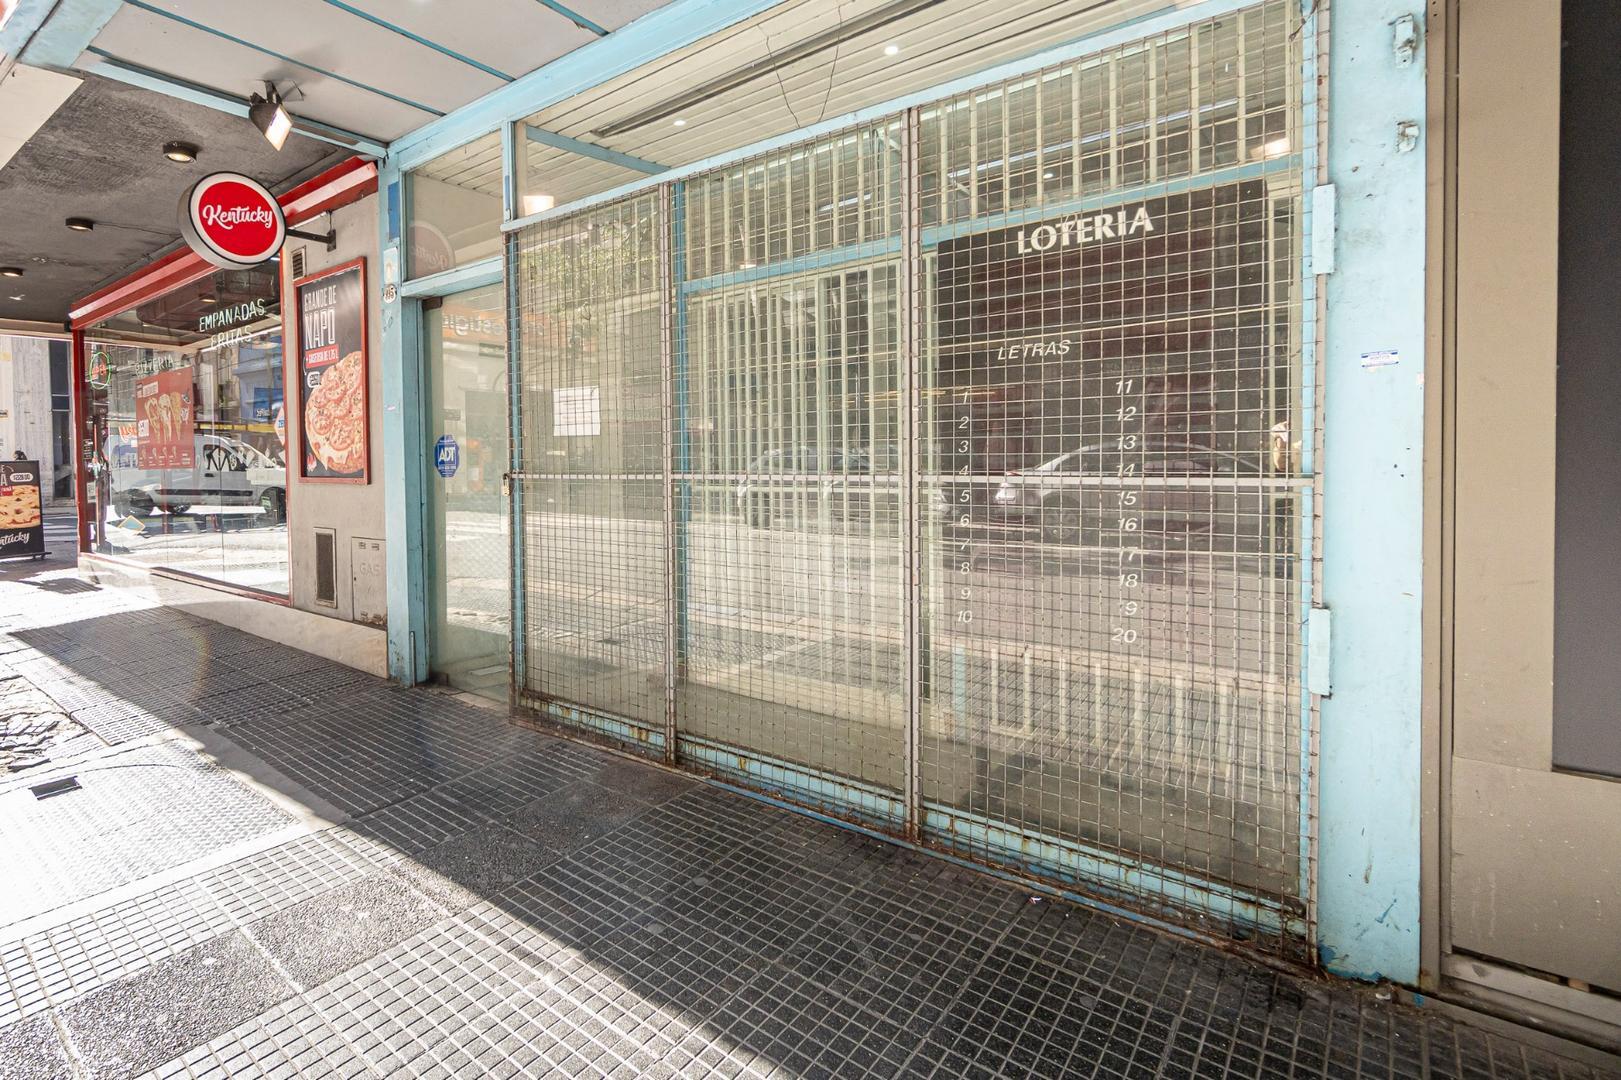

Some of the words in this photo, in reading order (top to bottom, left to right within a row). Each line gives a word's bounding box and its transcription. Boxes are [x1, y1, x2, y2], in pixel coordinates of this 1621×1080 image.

[202, 204, 273, 230] Kentucky
[1017, 206, 1155, 255] LOTERIA
[304, 288, 328, 312] GRANDE
[328, 284, 337, 305] DE
[199, 298, 265, 332] EMPANADAS
[304, 306, 336, 350] NAPO
[997, 339, 1072, 360] LETRAS
[1115, 379, 1133, 394] 11
[1116, 406, 1137, 421] 12
[959, 416, 970, 429] 2
[958, 440, 969, 453] 3
[1116, 435, 1137, 450] 13
[438, 447, 456, 462] ADT
[959, 465, 969, 476] 4
[1116, 463, 1136, 477] 14
[960, 490, 971, 503] 5
[1117, 491, 1137, 505] 15
[960, 514, 970, 527] 6
[1117, 517, 1138, 532] 16
[0, 531, 30, 546] ntucky
[961, 538, 970, 550] 7
[359, 562, 380, 577] GAS
[960, 562, 970, 574] 8
[1118, 573, 1138, 588] 18
[960, 587, 971, 600] 9
[957, 610, 973, 623] 10
[1111, 628, 1137, 643] 20
